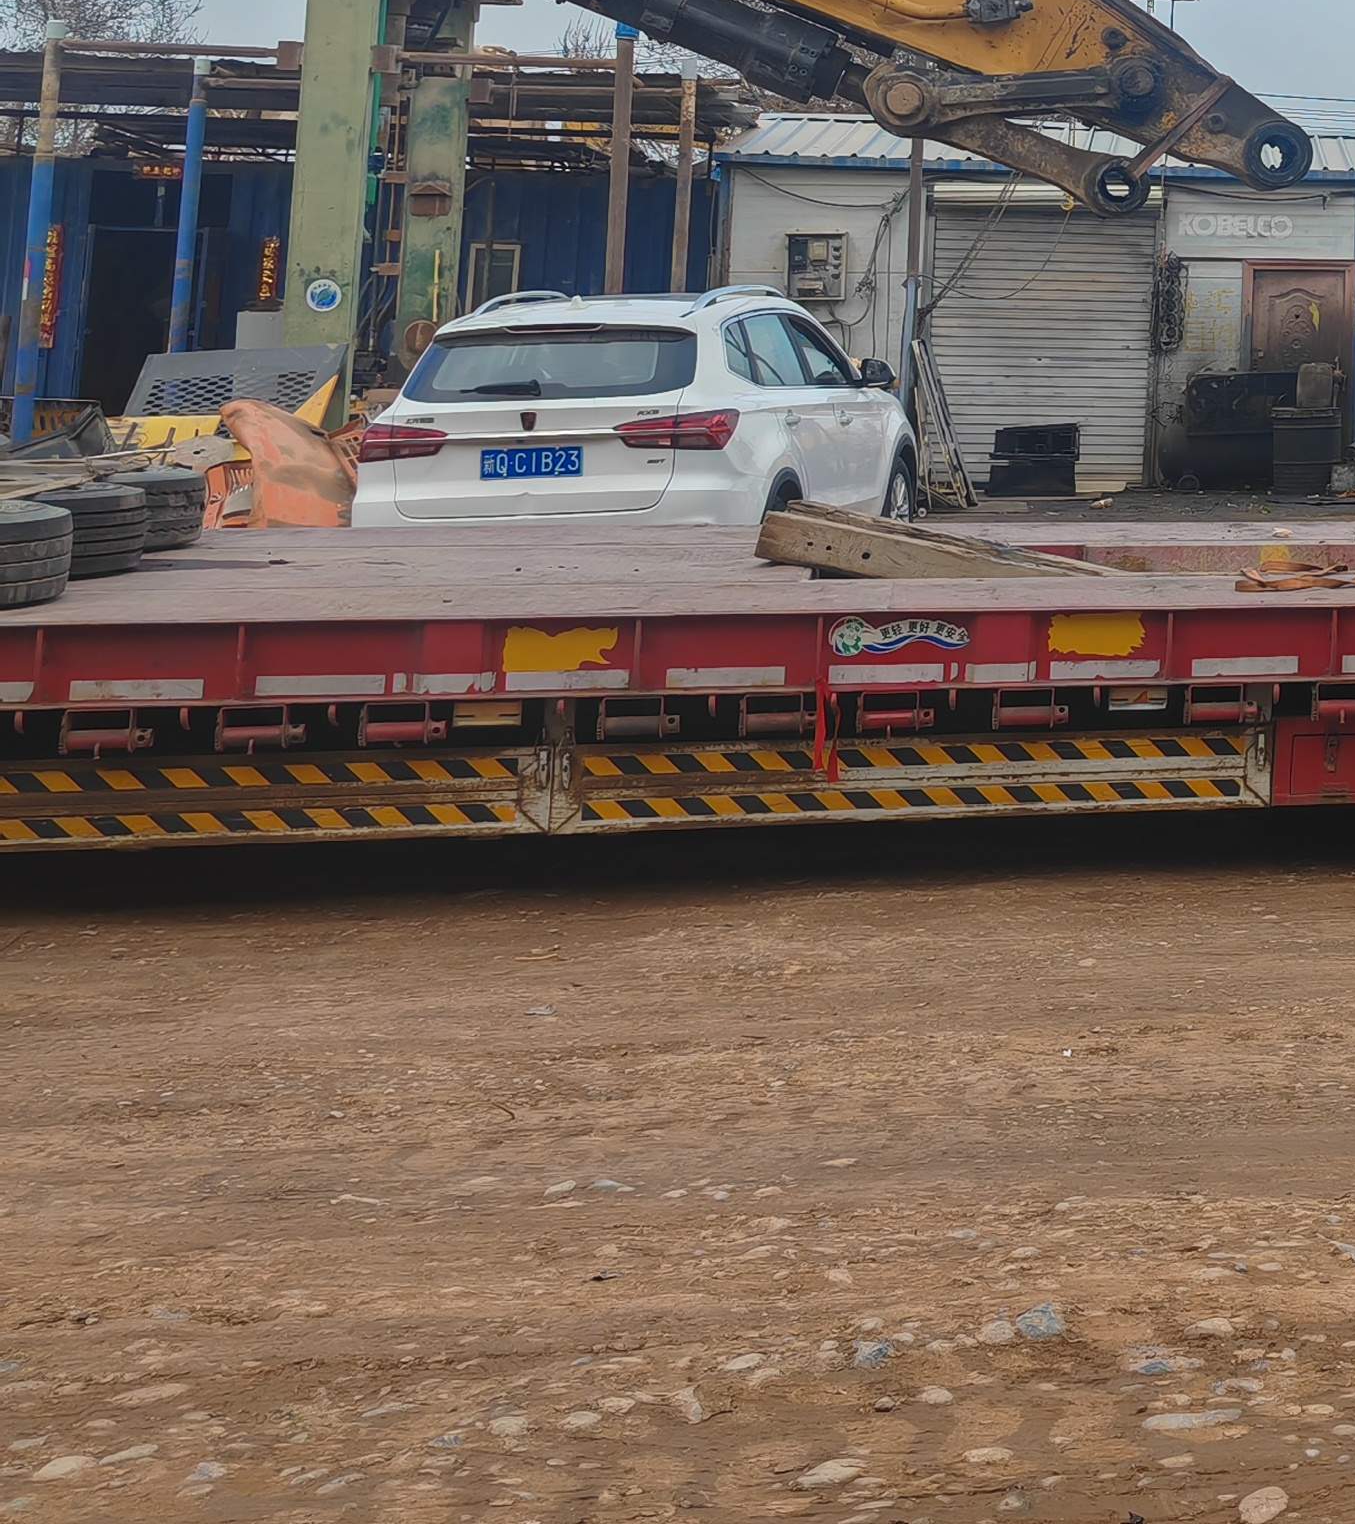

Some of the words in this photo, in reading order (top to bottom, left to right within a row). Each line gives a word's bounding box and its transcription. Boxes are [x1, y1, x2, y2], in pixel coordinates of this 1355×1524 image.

[1179, 214, 1294, 238] KOBELCO
[908, 620, 931, 634] 更好
[934, 621, 969, 642] 更安全
